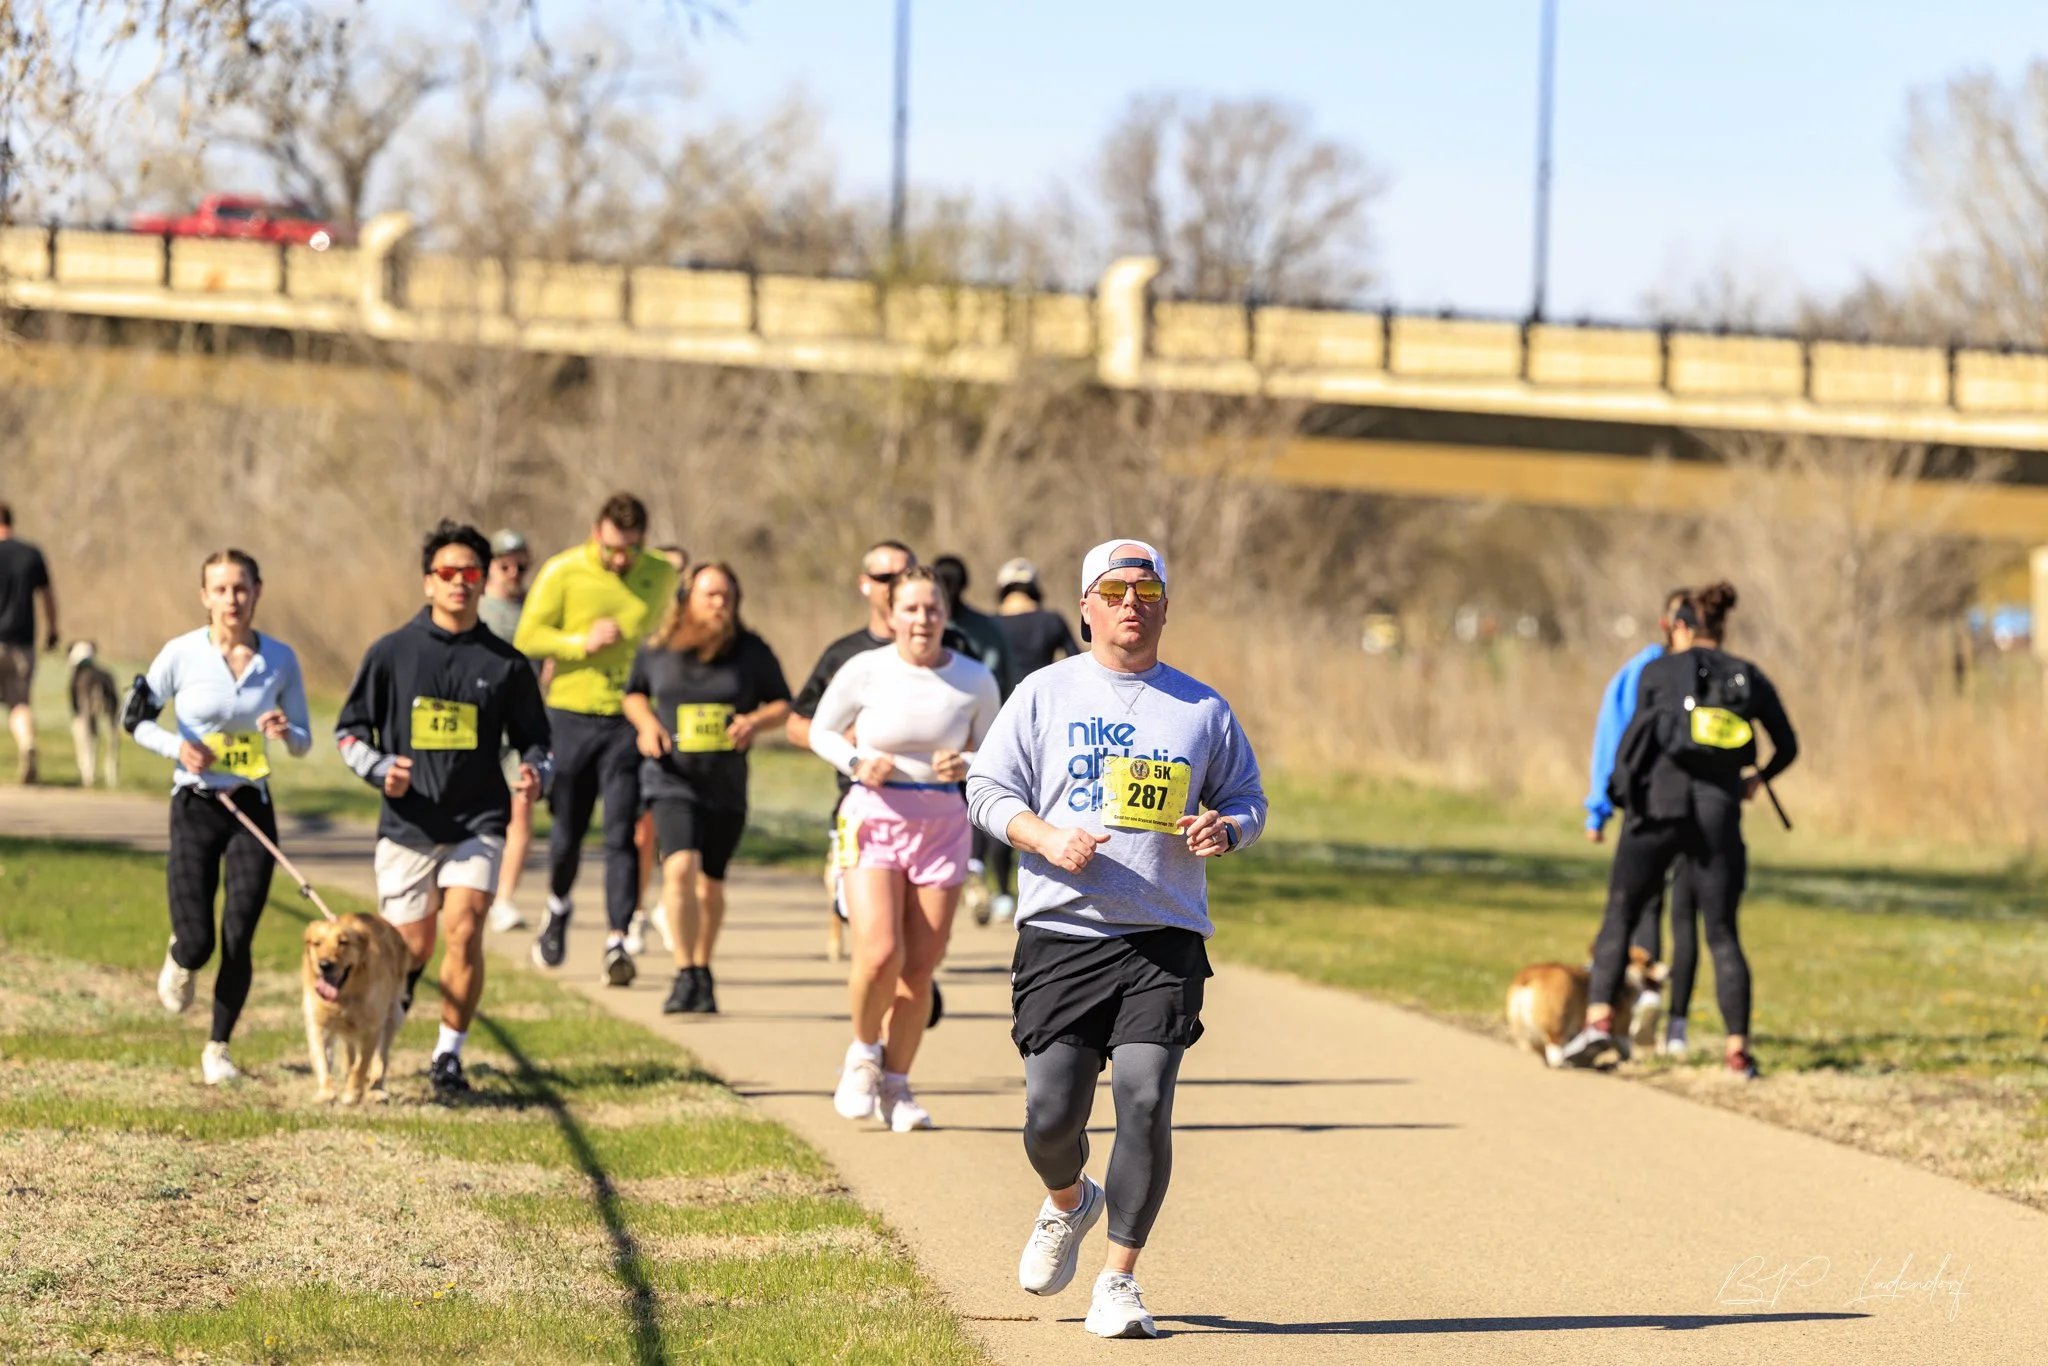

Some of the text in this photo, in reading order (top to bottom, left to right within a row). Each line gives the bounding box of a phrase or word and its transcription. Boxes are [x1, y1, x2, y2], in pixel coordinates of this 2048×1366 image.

[1068, 717, 1136, 747] nike
[1154, 765, 1171, 780] 5K
[1127, 783, 1168, 811] 287
